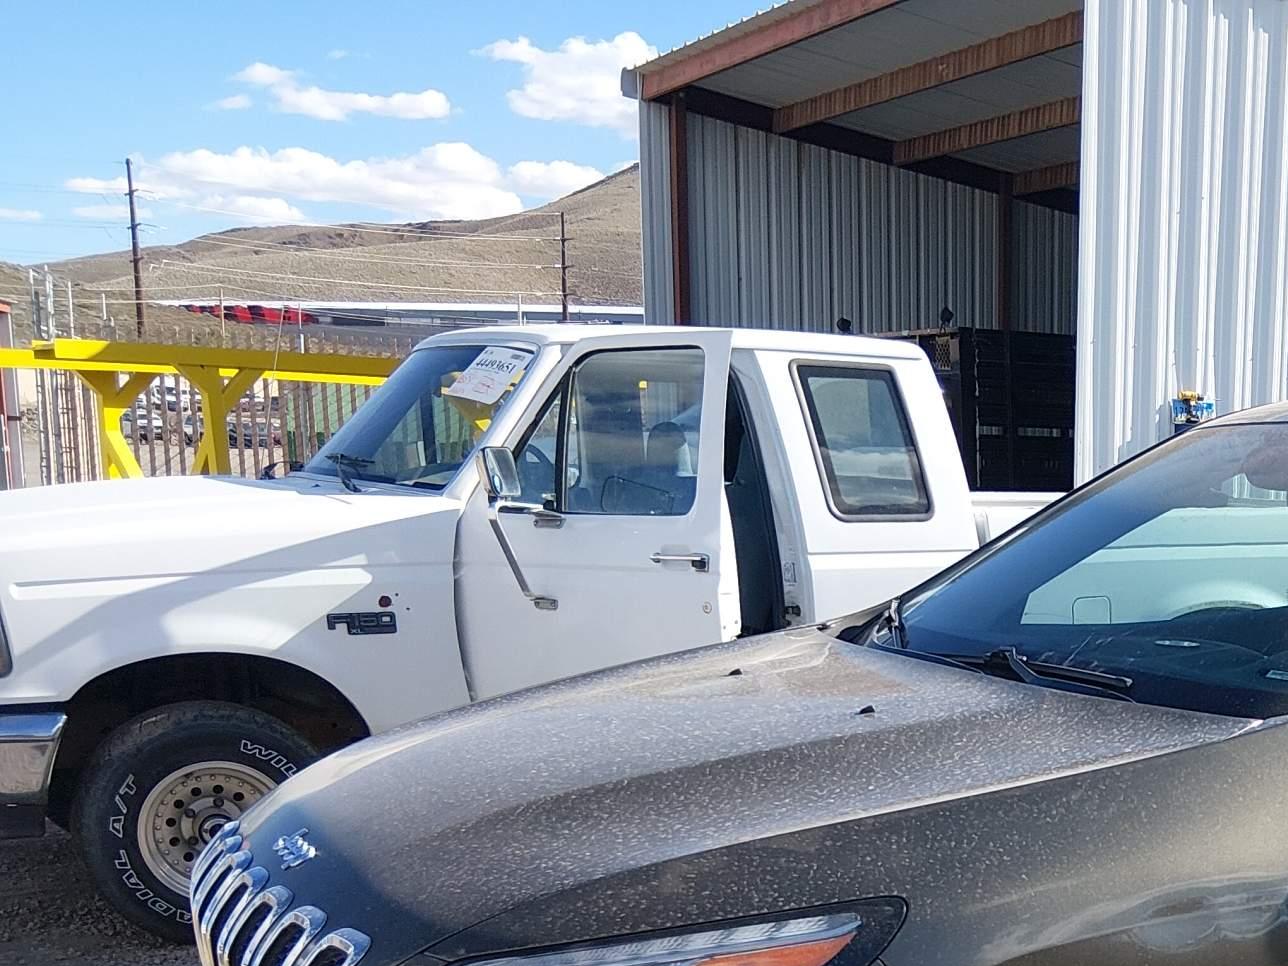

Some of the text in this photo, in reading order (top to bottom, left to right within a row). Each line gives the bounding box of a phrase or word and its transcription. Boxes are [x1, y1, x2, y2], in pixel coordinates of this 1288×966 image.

[476, 359, 517, 374] 44493651
[240, 739, 300, 778] WIL
[109, 774, 193, 923] ADIAL A/T
